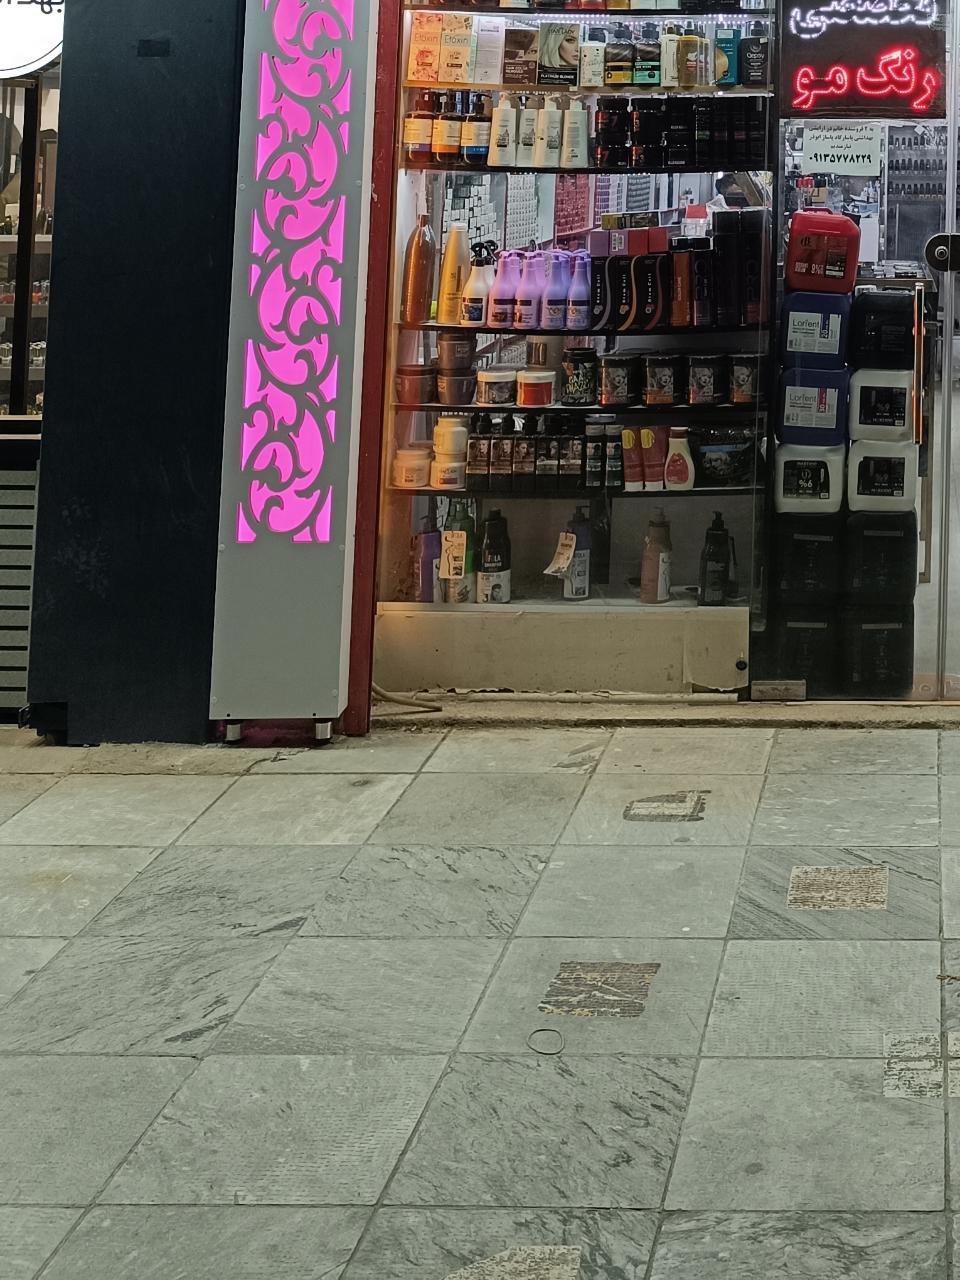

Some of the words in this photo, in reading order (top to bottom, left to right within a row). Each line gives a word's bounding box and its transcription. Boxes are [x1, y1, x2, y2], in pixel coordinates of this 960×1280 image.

[792, 66, 848, 111] مو
[856, 47, 938, 110] رنگ
[809, 152, 872, 163] ۰۹۱۳۵۷۷۸۲۲۹
